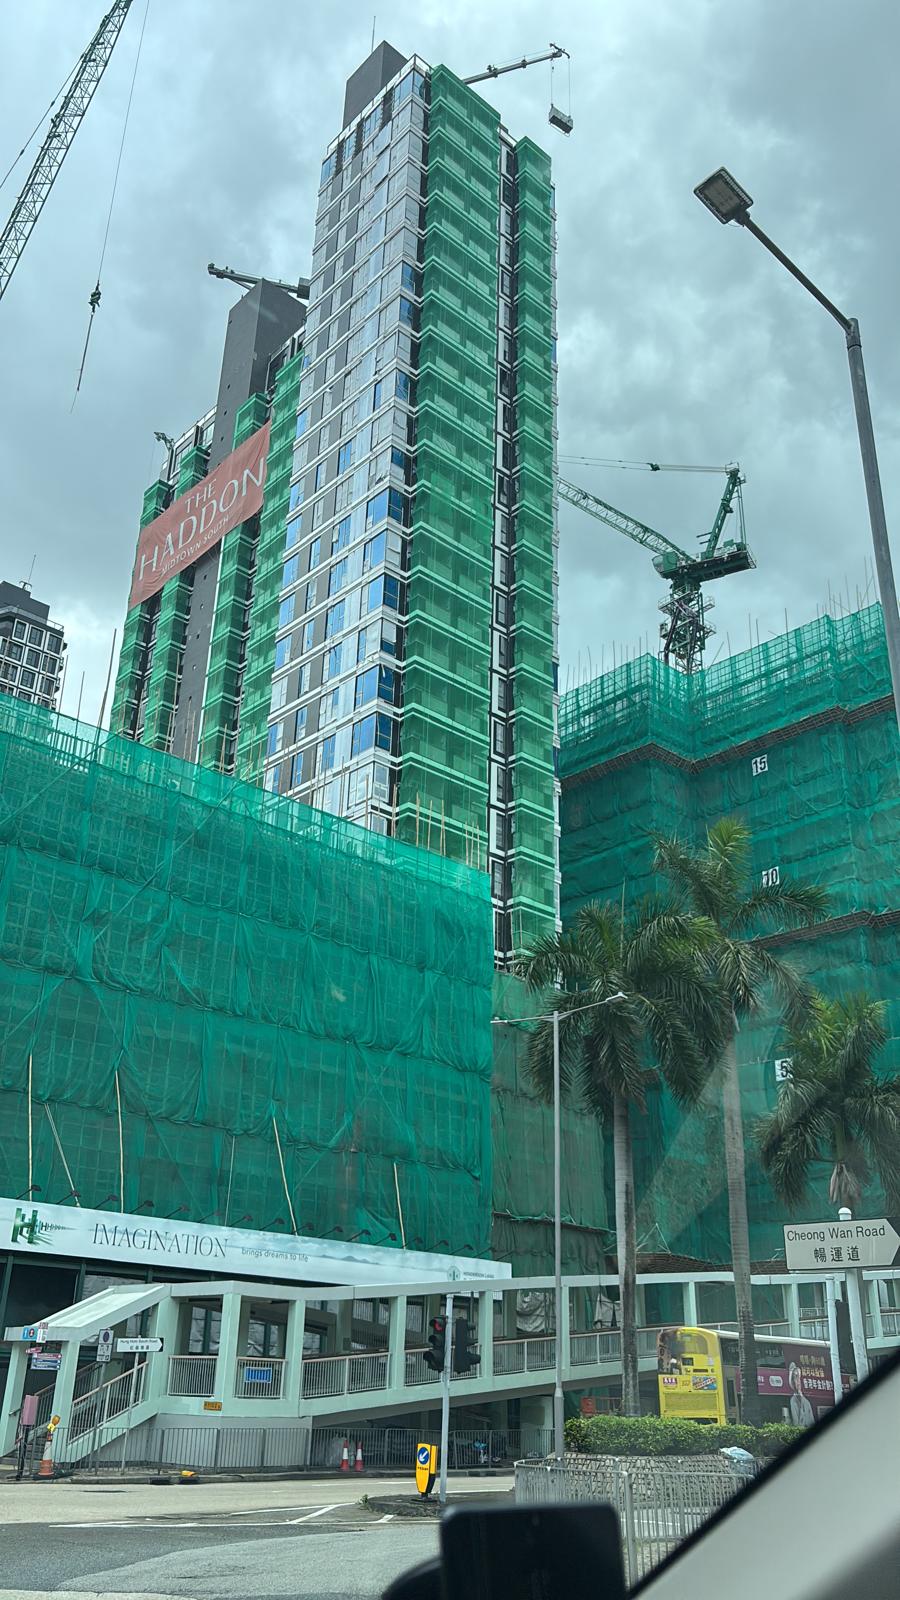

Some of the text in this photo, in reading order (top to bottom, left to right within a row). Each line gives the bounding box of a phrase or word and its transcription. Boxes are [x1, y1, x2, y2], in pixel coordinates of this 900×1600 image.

[184, 479, 217, 513] THE
[138, 457, 265, 581] HADDON
[160, 515, 230, 577] MIDTOWN SOUTH
[752, 756, 767, 774] 15
[92, 1223, 309, 1262] IMAGINATION brings dreams to life
[786, 1225, 886, 1242] Cheong Wan Road
[813, 1245, 861, 1263] 暢運道
